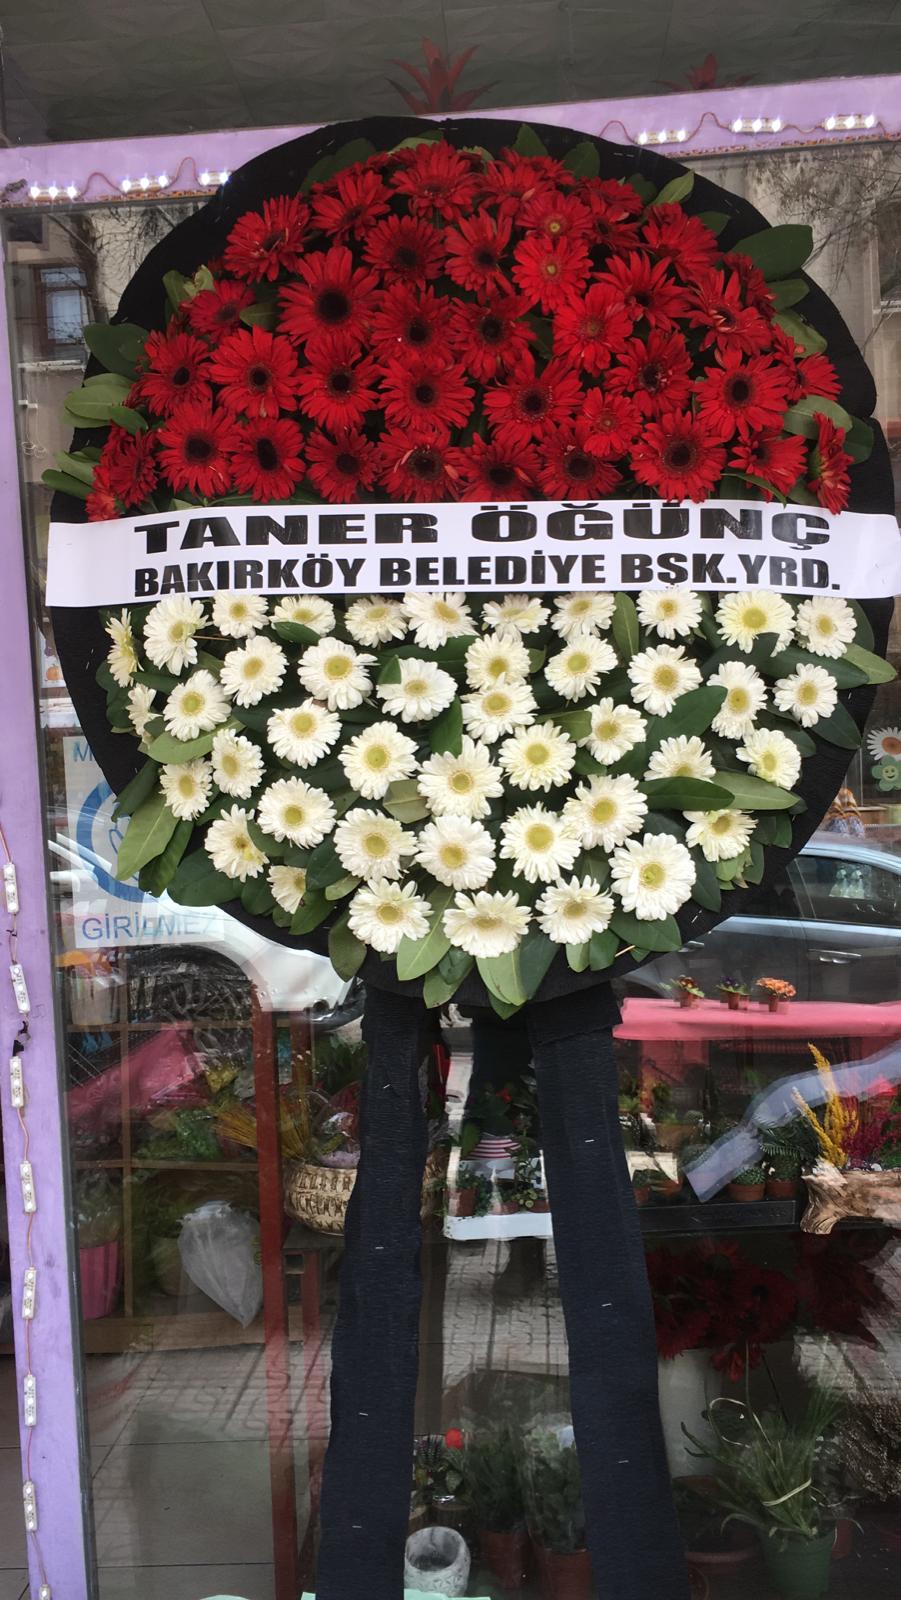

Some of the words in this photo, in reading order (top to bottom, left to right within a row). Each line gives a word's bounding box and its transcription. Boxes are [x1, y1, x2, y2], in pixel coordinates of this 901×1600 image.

[134, 512, 439, 555] TANER
[471, 502, 831, 551] ÖĞÜNÇ
[133, 553, 366, 598] BAKIRKÖY
[379, 549, 606, 586] BELEDİYE
[81, 911, 218, 940] GİRİLMEZ
